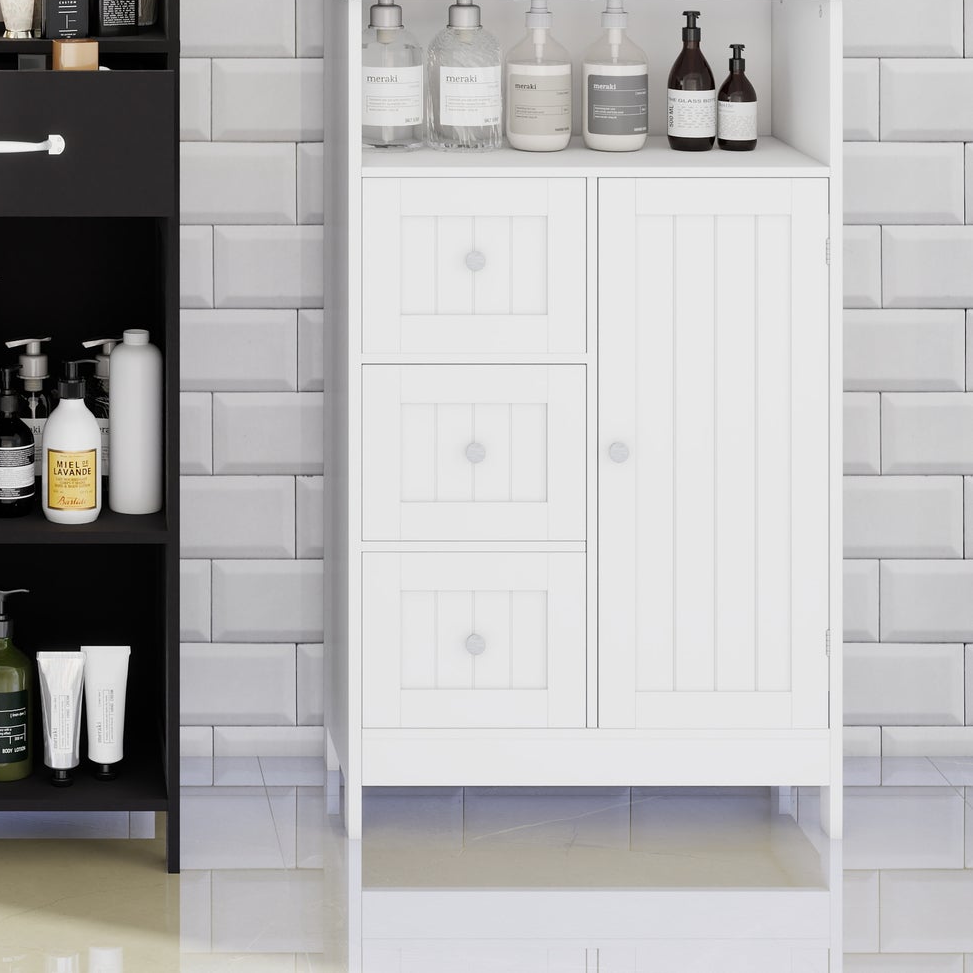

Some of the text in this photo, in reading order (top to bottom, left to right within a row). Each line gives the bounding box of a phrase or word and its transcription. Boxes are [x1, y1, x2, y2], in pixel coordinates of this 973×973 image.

[366, 75, 398, 83] meraki
[446, 75, 477, 83] meraki
[56, 460, 80, 469] MIEL
[53, 467, 92, 476] LAVANDE
